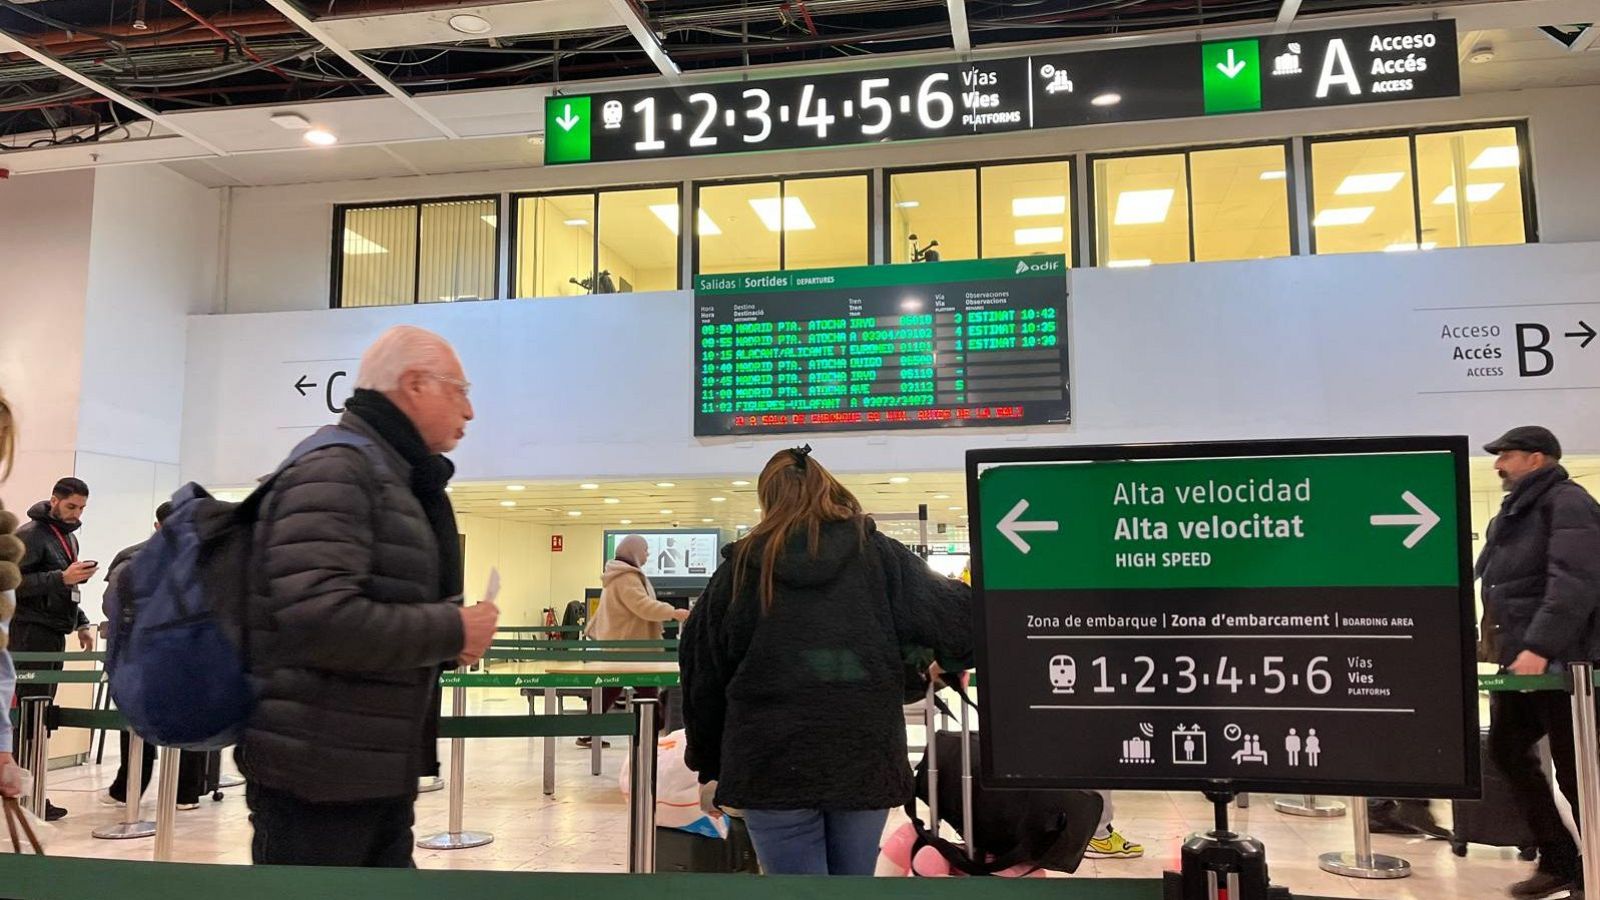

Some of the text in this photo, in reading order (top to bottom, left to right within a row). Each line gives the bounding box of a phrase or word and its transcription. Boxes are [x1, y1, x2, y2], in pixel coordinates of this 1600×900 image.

[1369, 32, 1436, 51] Acceso
[1315, 38, 1361, 97] A
[1370, 54, 1427, 74] Accés
[962, 68, 998, 86] Vías
[1371, 78, 1413, 93] ACCESS
[962, 91, 999, 108] Vies
[962, 111, 1021, 125] PLATFORMS
[1030, 261, 1059, 271] adif
[700, 276, 835, 290] Salidas Sortides DEPARTURES
[808, 319, 846, 331] ATOCHA
[968, 310, 1015, 323] ESTIMAT
[1020, 308, 1056, 321] 10:42
[808, 332, 846, 344] ATOCHA
[968, 323, 1016, 336] ESTIMAT
[1441, 324, 1500, 339] Acceso
[968, 337, 1016, 350] ESTIMAT
[1515, 322, 1554, 378] B
[1453, 344, 1502, 361] Accés
[1467, 367, 1504, 377] ACCESS
[1113, 478, 1311, 505] Alta velocidad
[1114, 514, 1305, 541] Alta velocitat
[1115, 551, 1212, 568] HIGH SPEED
[1027, 612, 1414, 633] Zona de embarque Zona d'embarcament BOARDING AREA
[1347, 655, 1373, 669] Vías
[1348, 672, 1374, 684] Vies
[1347, 687, 1391, 696] PLATFORMS
